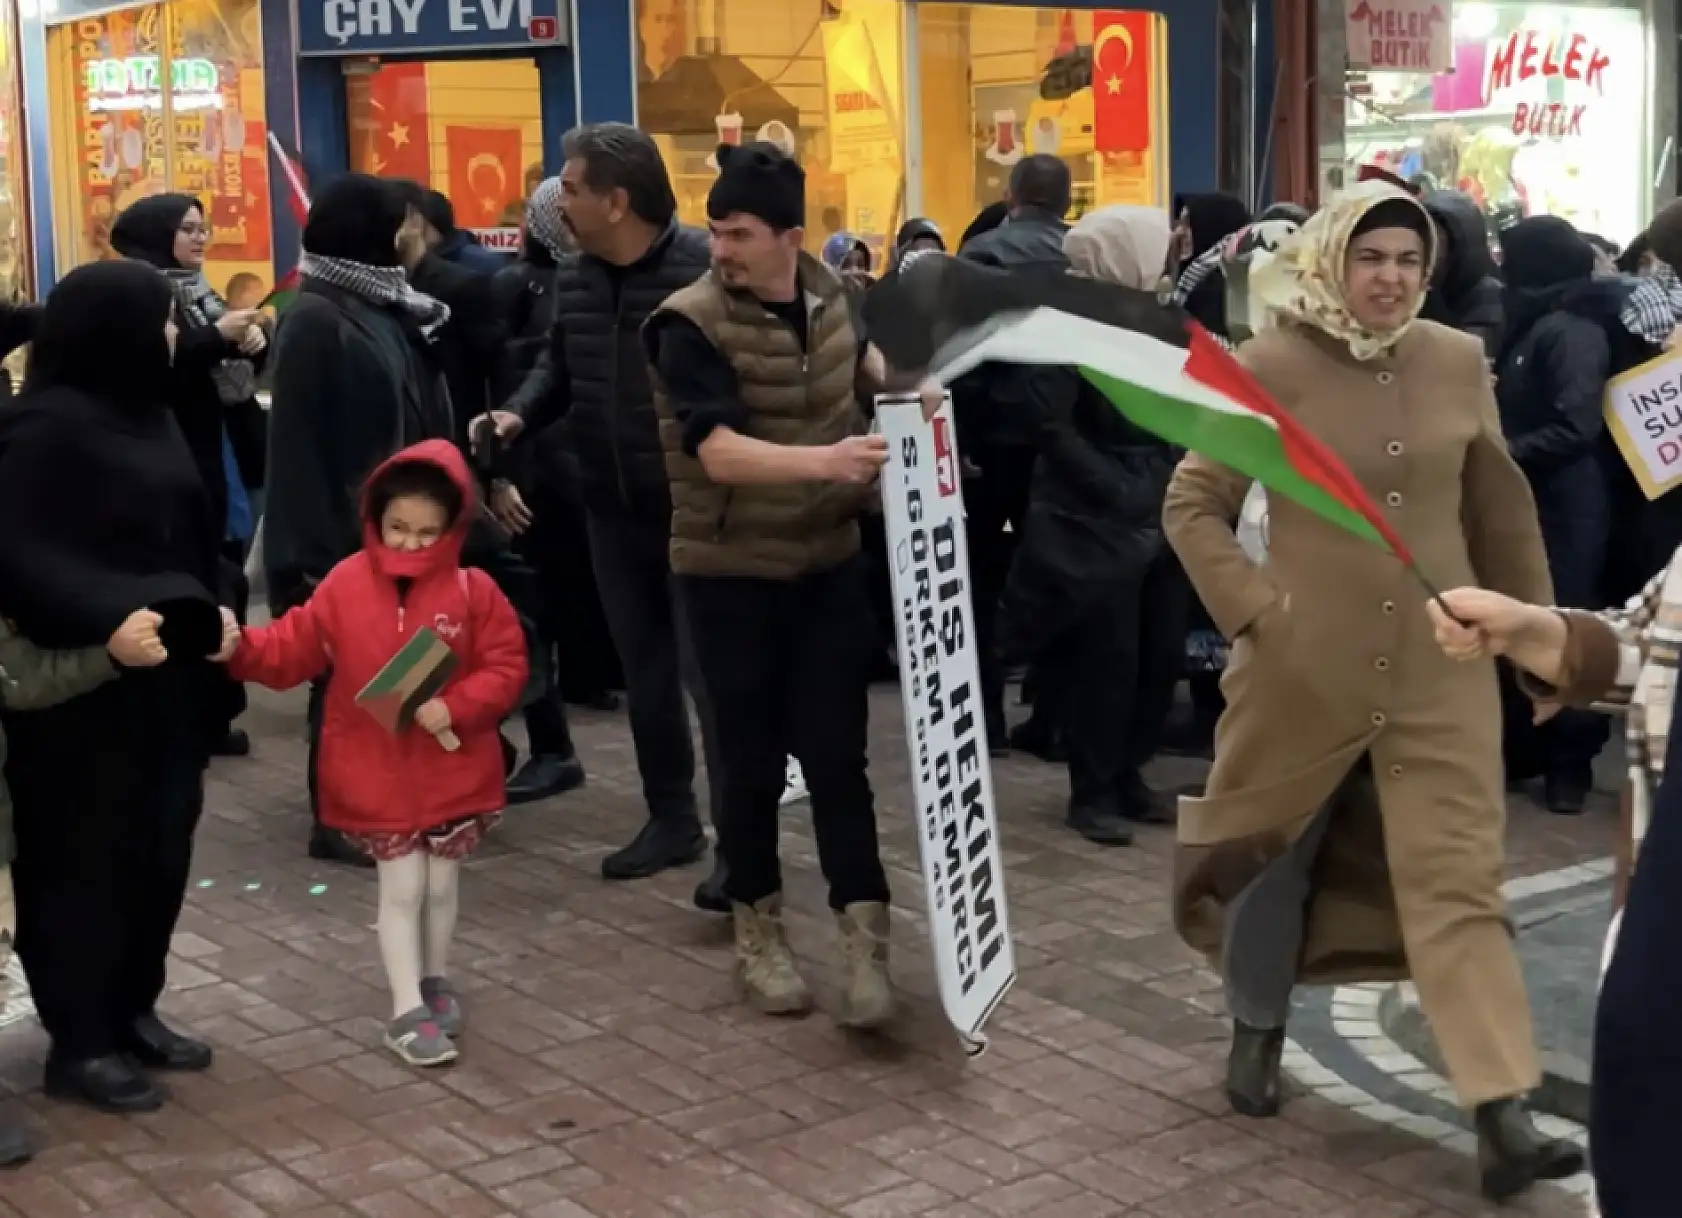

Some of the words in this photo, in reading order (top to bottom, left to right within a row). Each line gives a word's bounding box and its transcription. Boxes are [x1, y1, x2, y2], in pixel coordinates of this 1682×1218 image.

[324, 0, 424, 45] ÇAY
[1368, 9, 1433, 37] MELEK
[1486, 29, 1610, 104] MELEK
[1628, 372, 1682, 416] İNS
[1656, 434, 1682, 466] D
[902, 434, 945, 727] S.GÖRKEM
[935, 749, 977, 996] DEMİRCİ
[932, 516, 965, 658] DİŞ
[949, 680, 1005, 972] HEKİMİ
